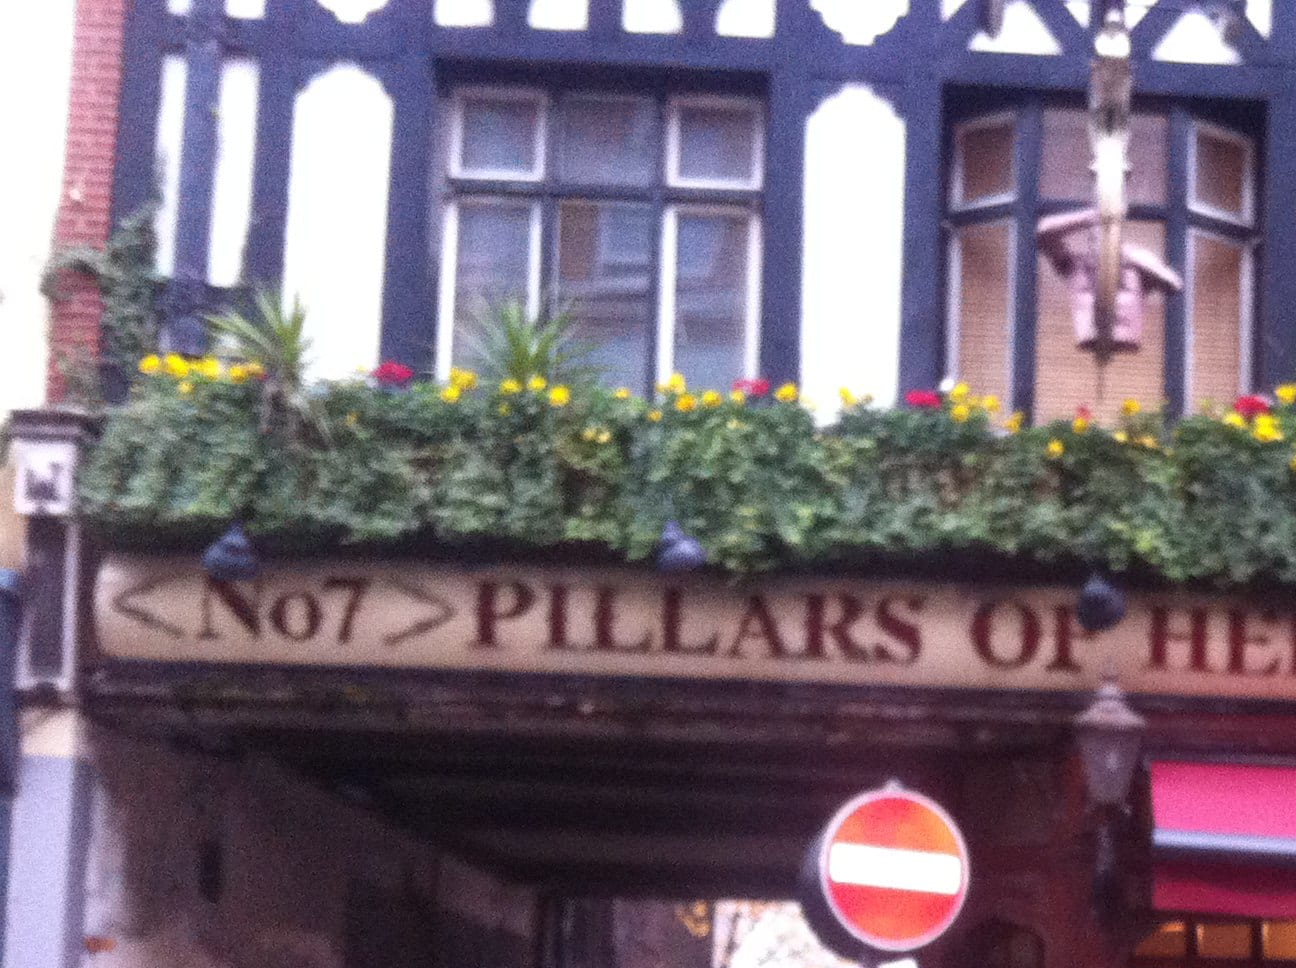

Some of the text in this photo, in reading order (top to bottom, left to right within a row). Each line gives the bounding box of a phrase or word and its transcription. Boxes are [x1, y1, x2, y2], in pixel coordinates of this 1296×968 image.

[199, 573, 372, 645] No7
[466, 580, 924, 666] PILLARS
[970, 598, 1102, 674] OF
